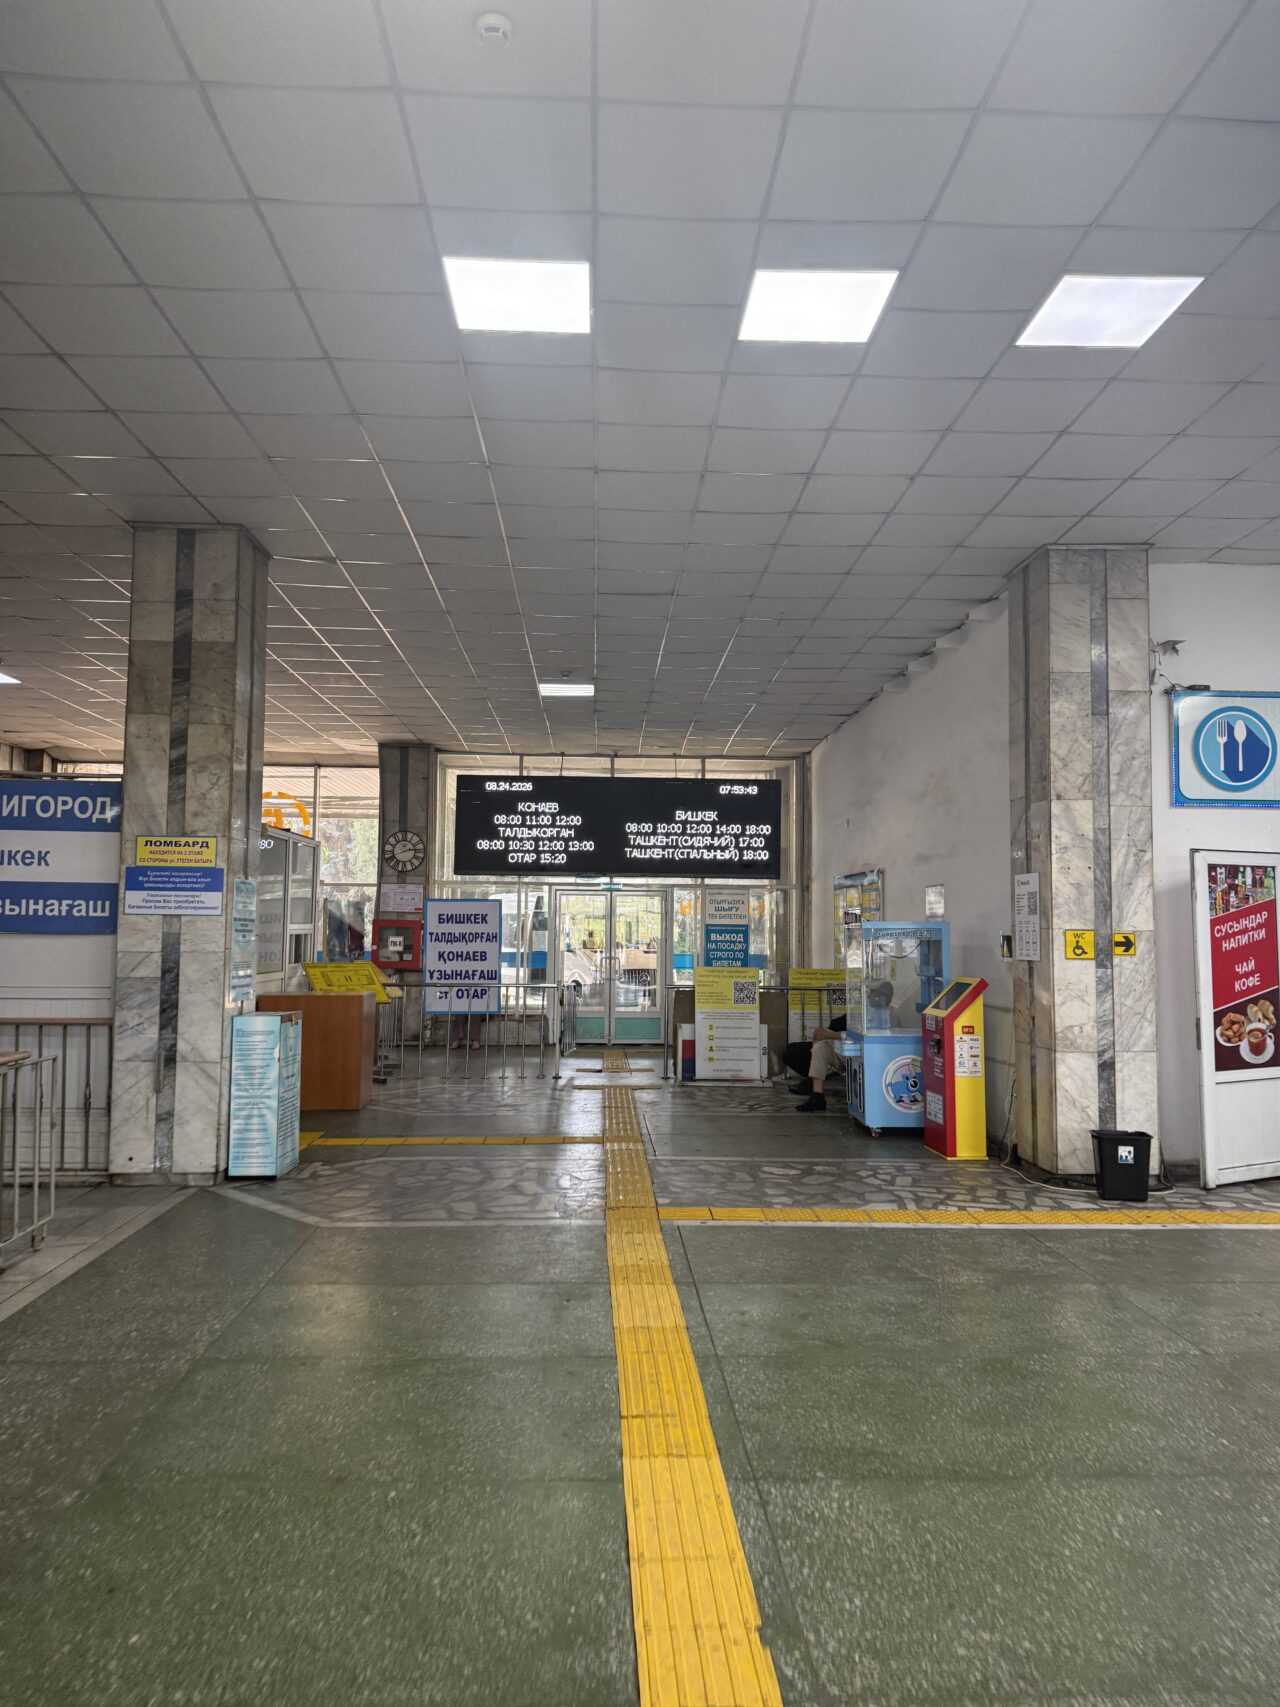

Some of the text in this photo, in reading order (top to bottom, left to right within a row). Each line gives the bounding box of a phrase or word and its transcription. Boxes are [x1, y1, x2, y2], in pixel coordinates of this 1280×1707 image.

[719, 785, 758, 795] 07:53:43
[517, 802, 559, 813] КОНАЕВ
[494, 815, 582, 826] 08:00 11:00 12:00
[675, 810, 719, 822] БИШКЕК
[498, 827, 575, 839] ТАЛДЫКОРГАН
[625, 823, 772, 835] 08:00 10:00 12:00 14:00 18:00
[144, 840, 210, 849] ЛОМБАРД
[476, 840, 595, 851] 08:00 10:30 12:00 13:00
[738, 837, 765, 848] 17:00
[508, 853, 567, 864] ОТАР 15:20
[742, 849, 769, 860] 18:00
[437, 913, 488, 925] БИШКЕК
[1214, 911, 1268, 938] СУСЫНДАР
[428, 932, 498, 946] ТАЛДЫҚОРҒАН
[710, 933, 744, 942] ВЫХОД
[1073, 932, 1086, 940] WC
[1222, 928, 1266, 952] НАПИТКИ
[707, 942, 747, 951] НА ПОСАДКУ
[437, 950, 488, 964] ҚОНАЕВ
[709, 951, 734, 959] СТРОГО
[1235, 957, 1255, 975] ЧАЙ
[428, 969, 498, 981] ҰЗЫНАҒАШ
[1234, 973, 1261, 993] КОФЕ
